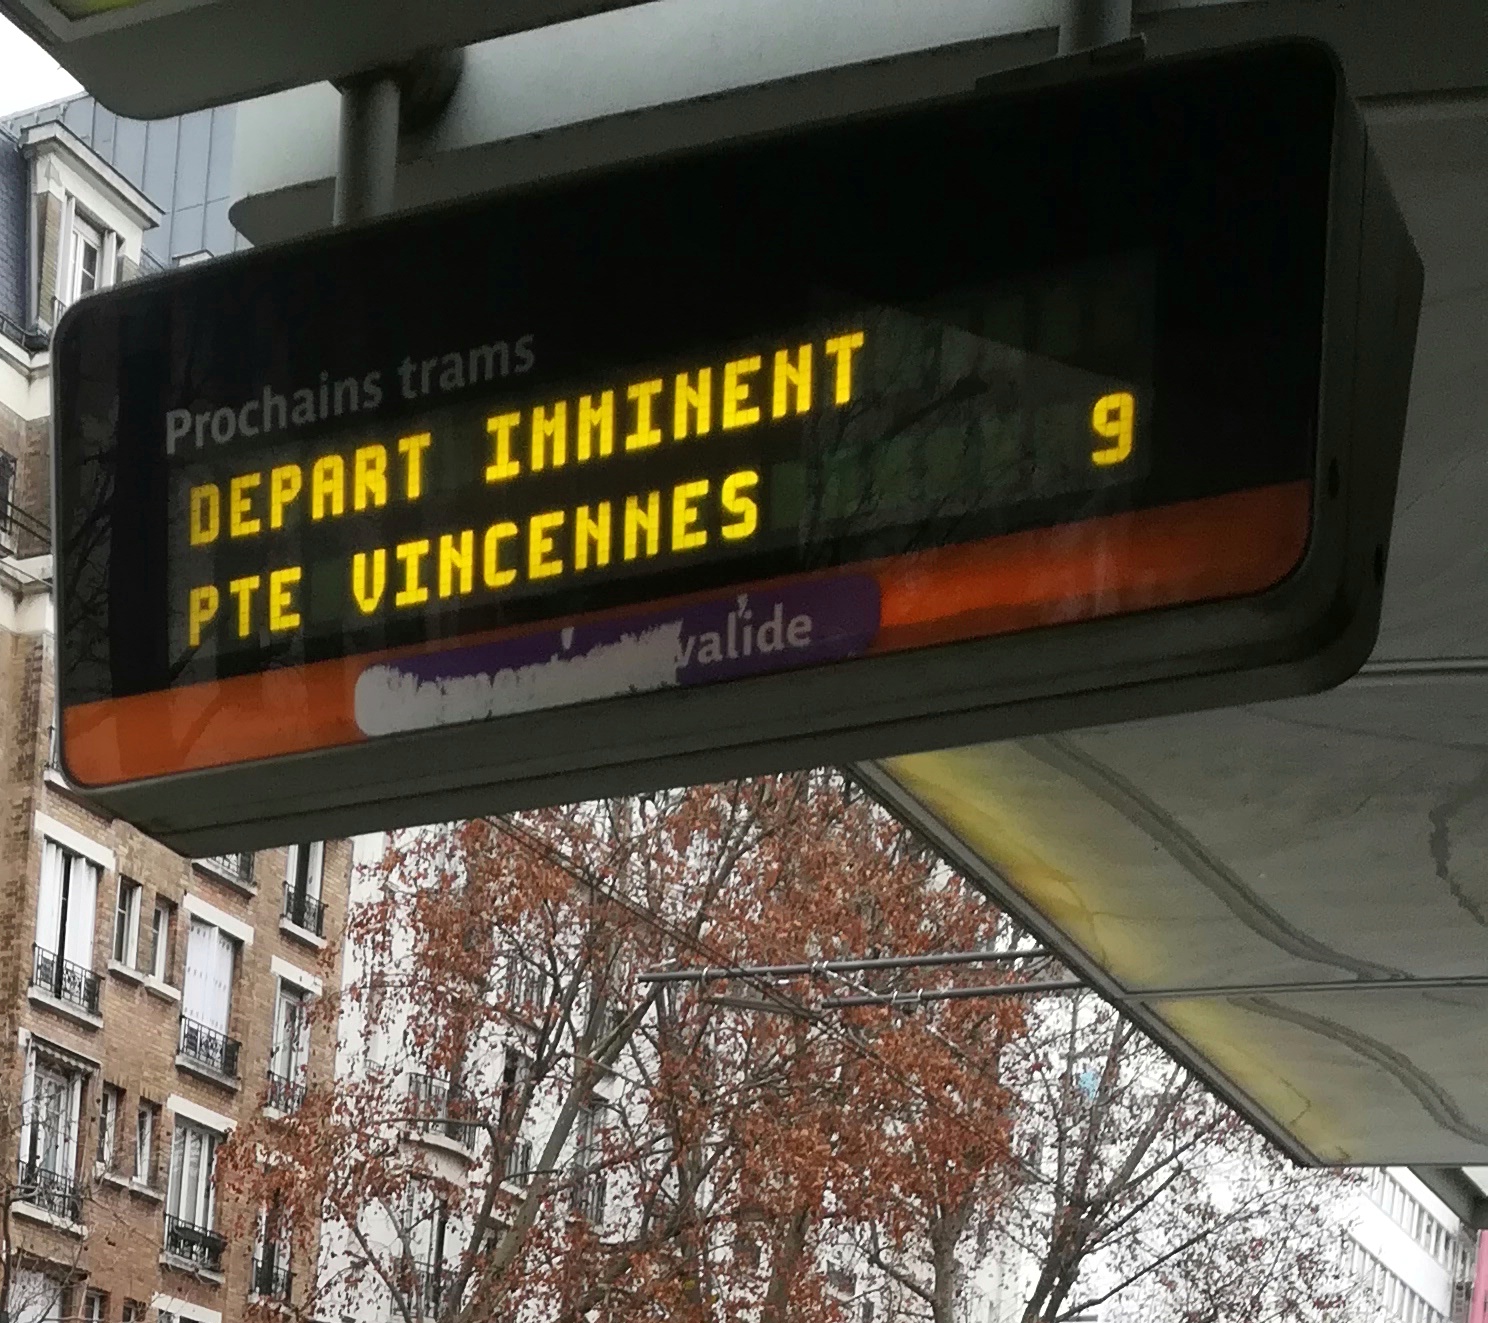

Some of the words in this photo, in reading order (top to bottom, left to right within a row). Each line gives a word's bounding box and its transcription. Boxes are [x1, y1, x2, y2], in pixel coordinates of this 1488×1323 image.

[165, 370, 383, 454] Prochains
[398, 334, 535, 399] trams
[192, 434, 431, 544] DEPART
[485, 332, 864, 483] IMMINENT
[190, 568, 302, 644] PTE
[352, 472, 759, 613] VINCENNES
[1092, 393, 1134, 464] 9
